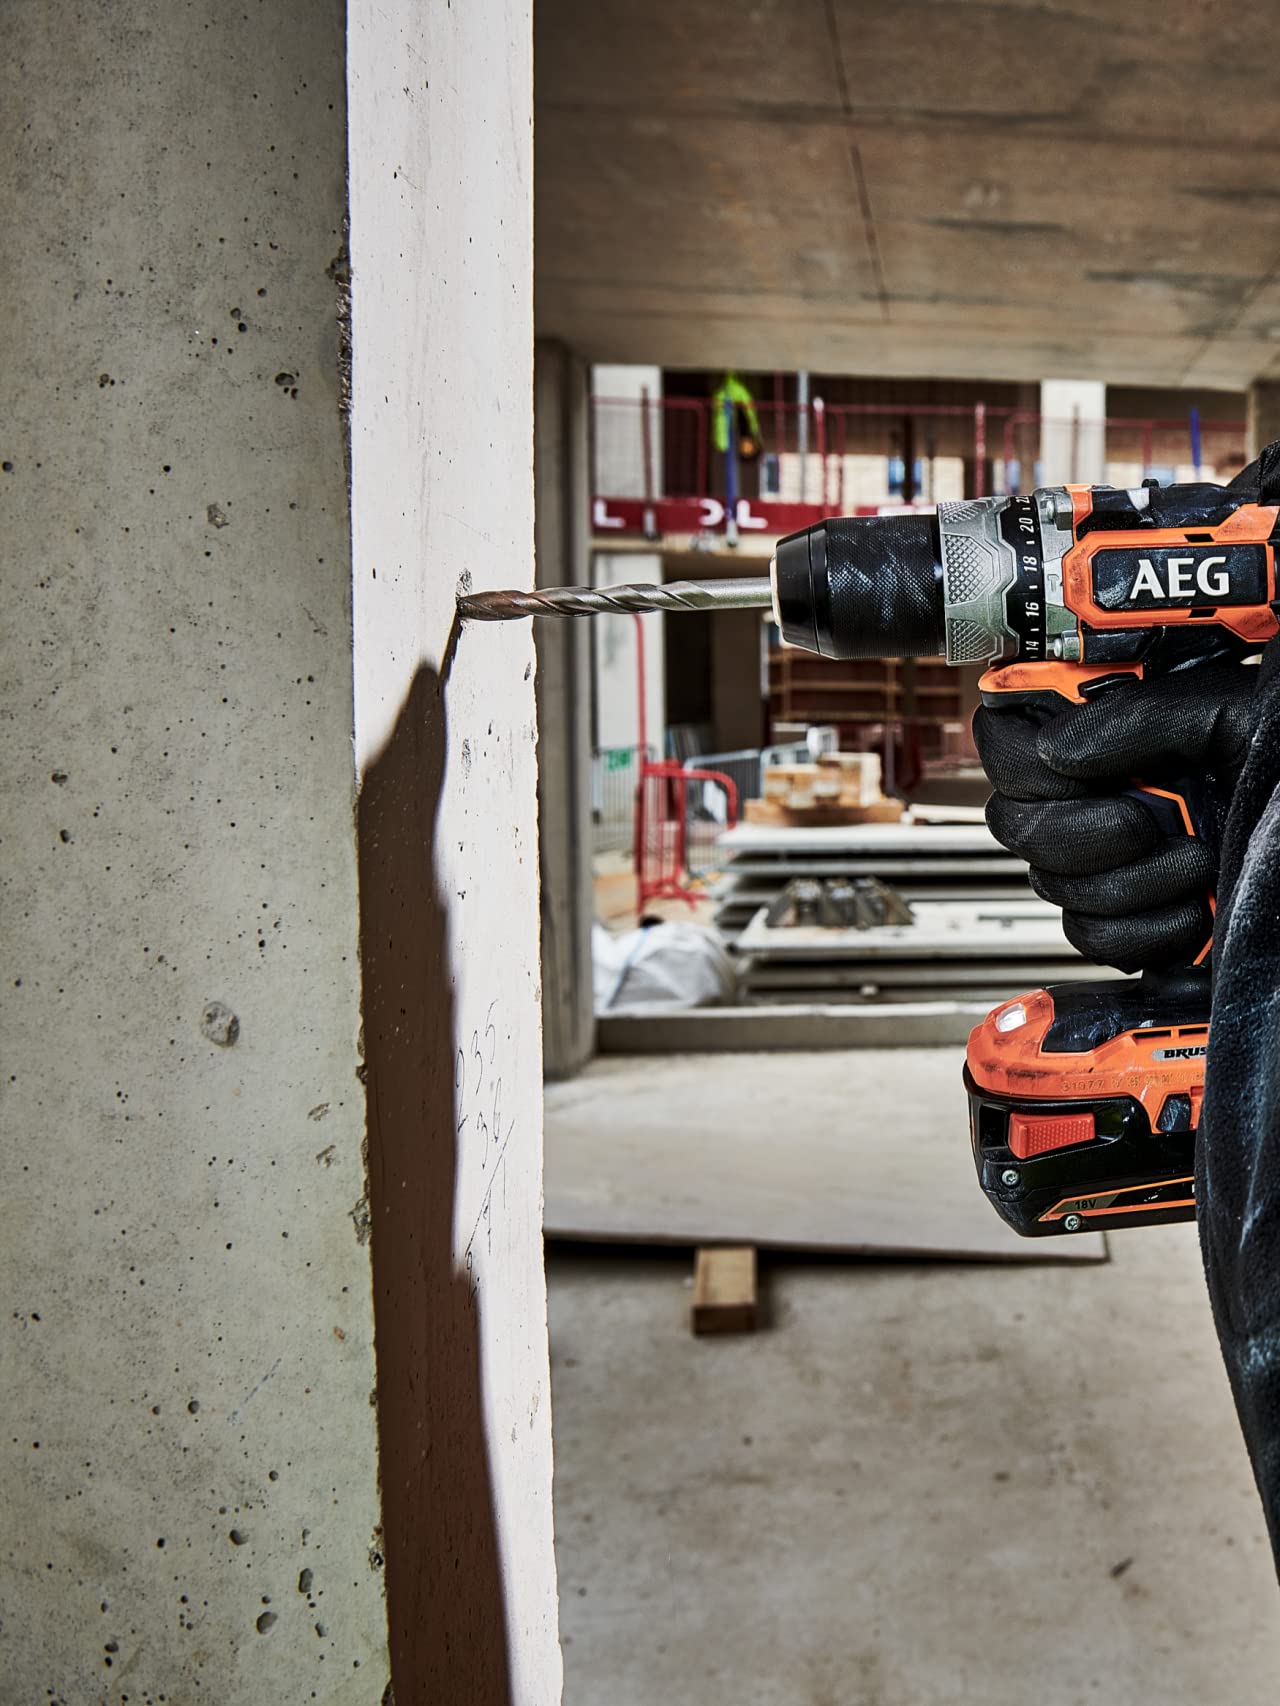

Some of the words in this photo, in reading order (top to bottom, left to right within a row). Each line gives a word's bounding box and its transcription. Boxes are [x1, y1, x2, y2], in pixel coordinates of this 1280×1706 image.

[1019, 517, 1035, 533] 20
[1023, 555, 1038, 572] 18
[1129, 556, 1230, 600] AEG
[1025, 601, 1040, 617] 16
[1025, 640, 1040, 651] 14
[1075, 1199, 1097, 1210] 18V
